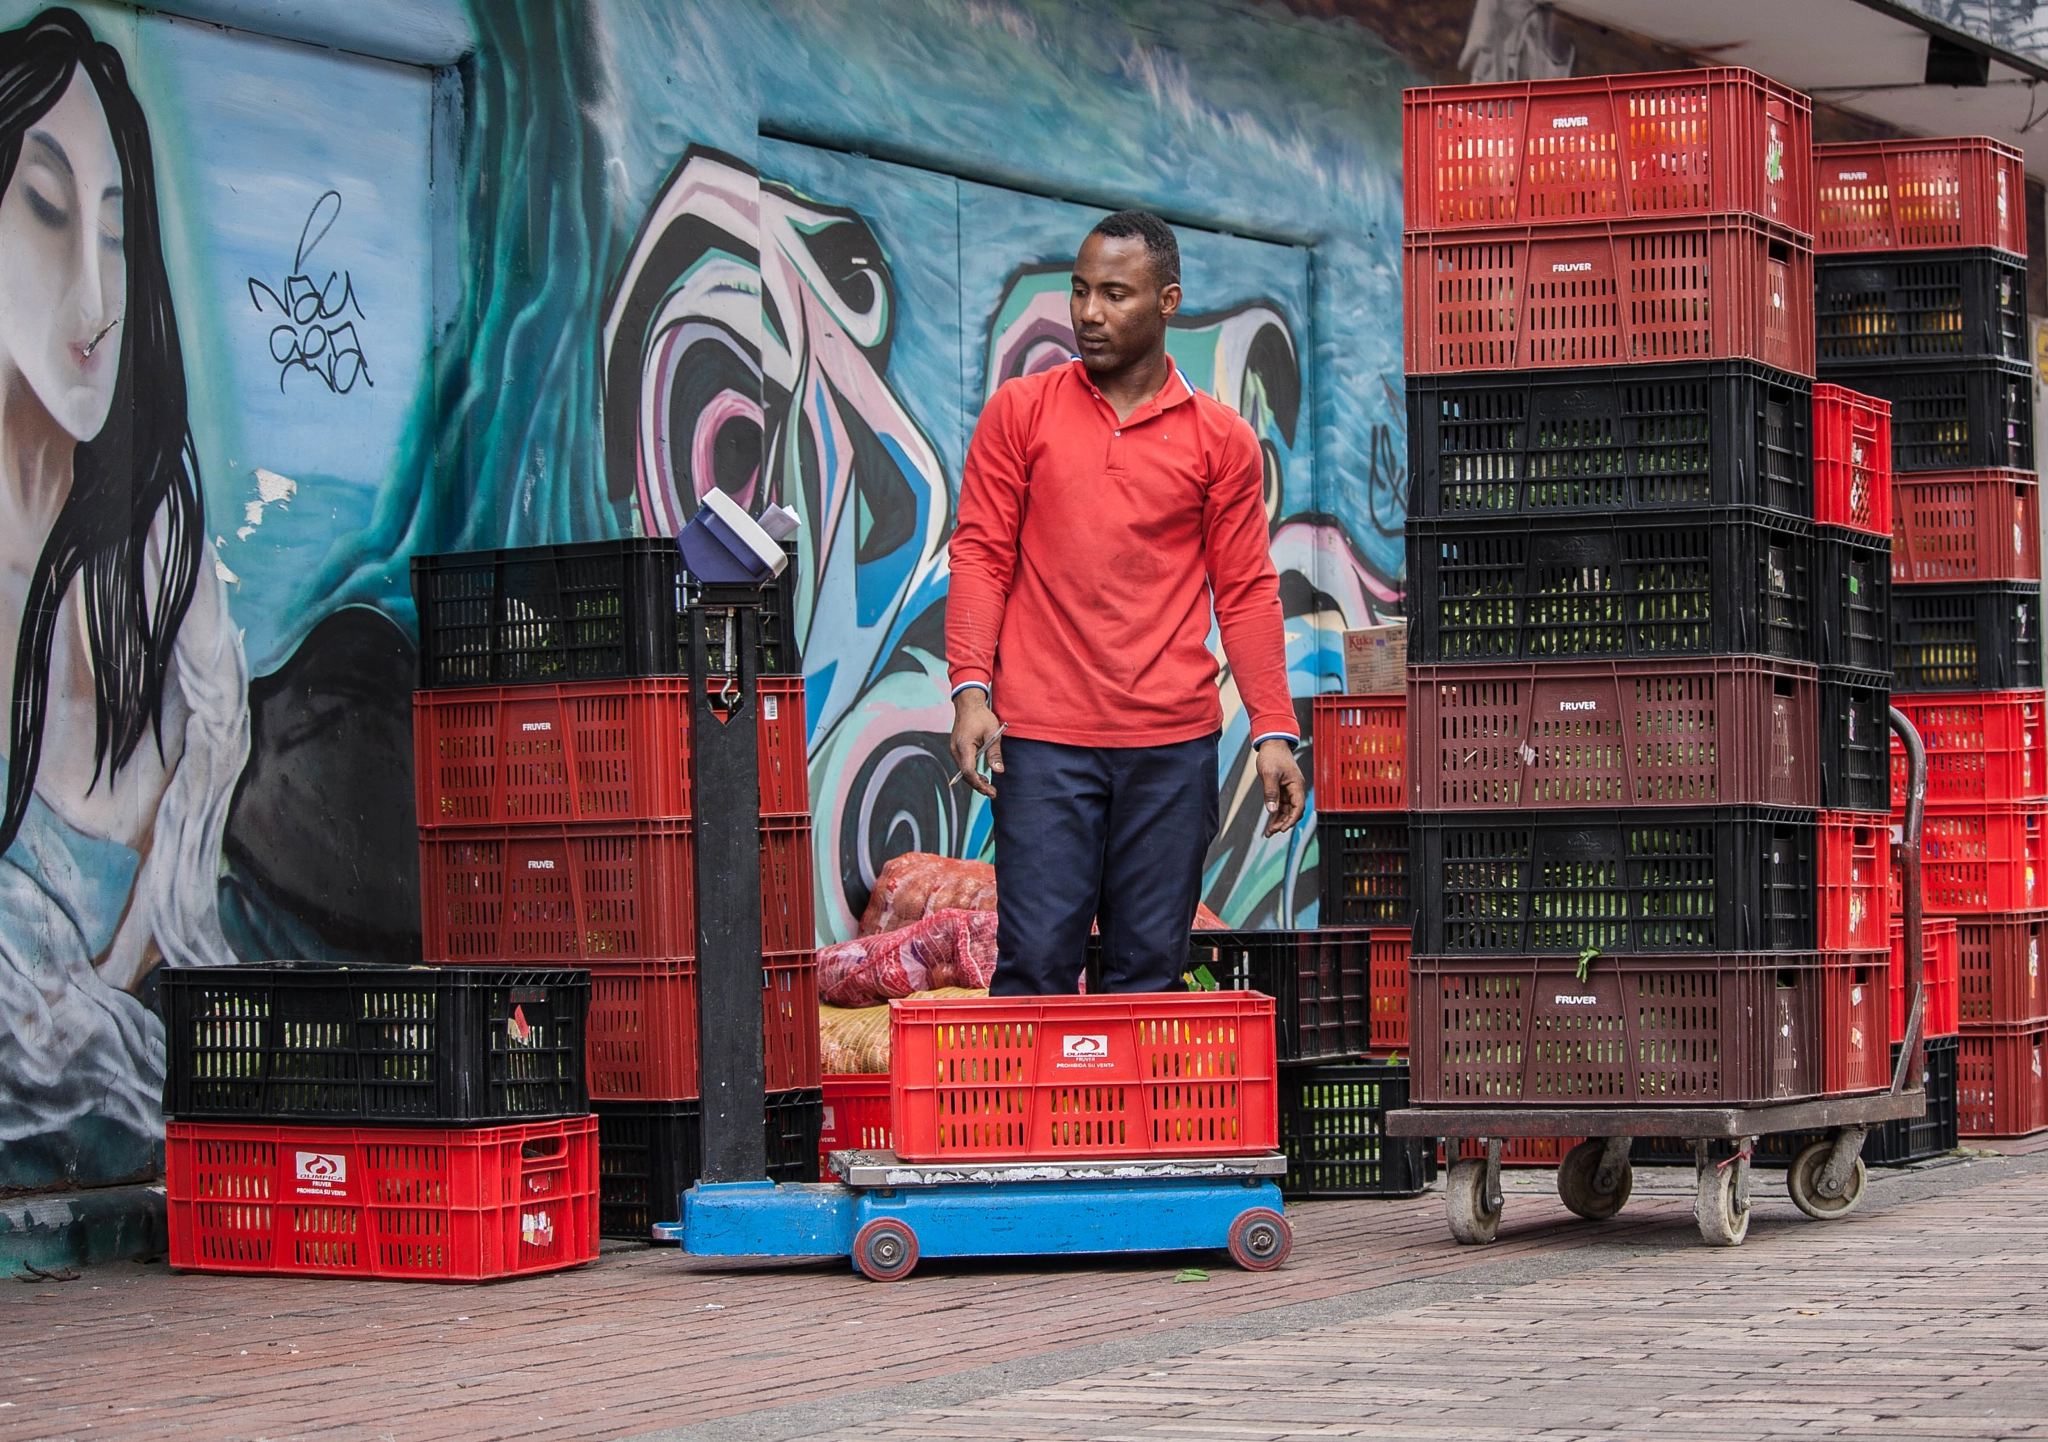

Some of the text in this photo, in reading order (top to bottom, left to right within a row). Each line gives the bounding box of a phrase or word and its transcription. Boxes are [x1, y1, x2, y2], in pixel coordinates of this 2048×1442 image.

[1552, 116, 1589, 129] FRUVER
[1838, 171, 1868, 181] FRUVER
[1552, 262, 1592, 273] FRUVER
[1348, 634, 1374, 652] Kiska
[1560, 701, 1596, 712] FRUVER
[522, 722, 552, 731] FRUVER
[527, 860, 555, 869] FRUVER
[1555, 995, 1597, 1005] FRUVER
[300, 1173, 343, 1181] OLIMPICA
[312, 1180, 332, 1188] FRUVER
[296, 1187, 324, 1195] PROHIBIDA
[323, 1188, 331, 1196] SU
